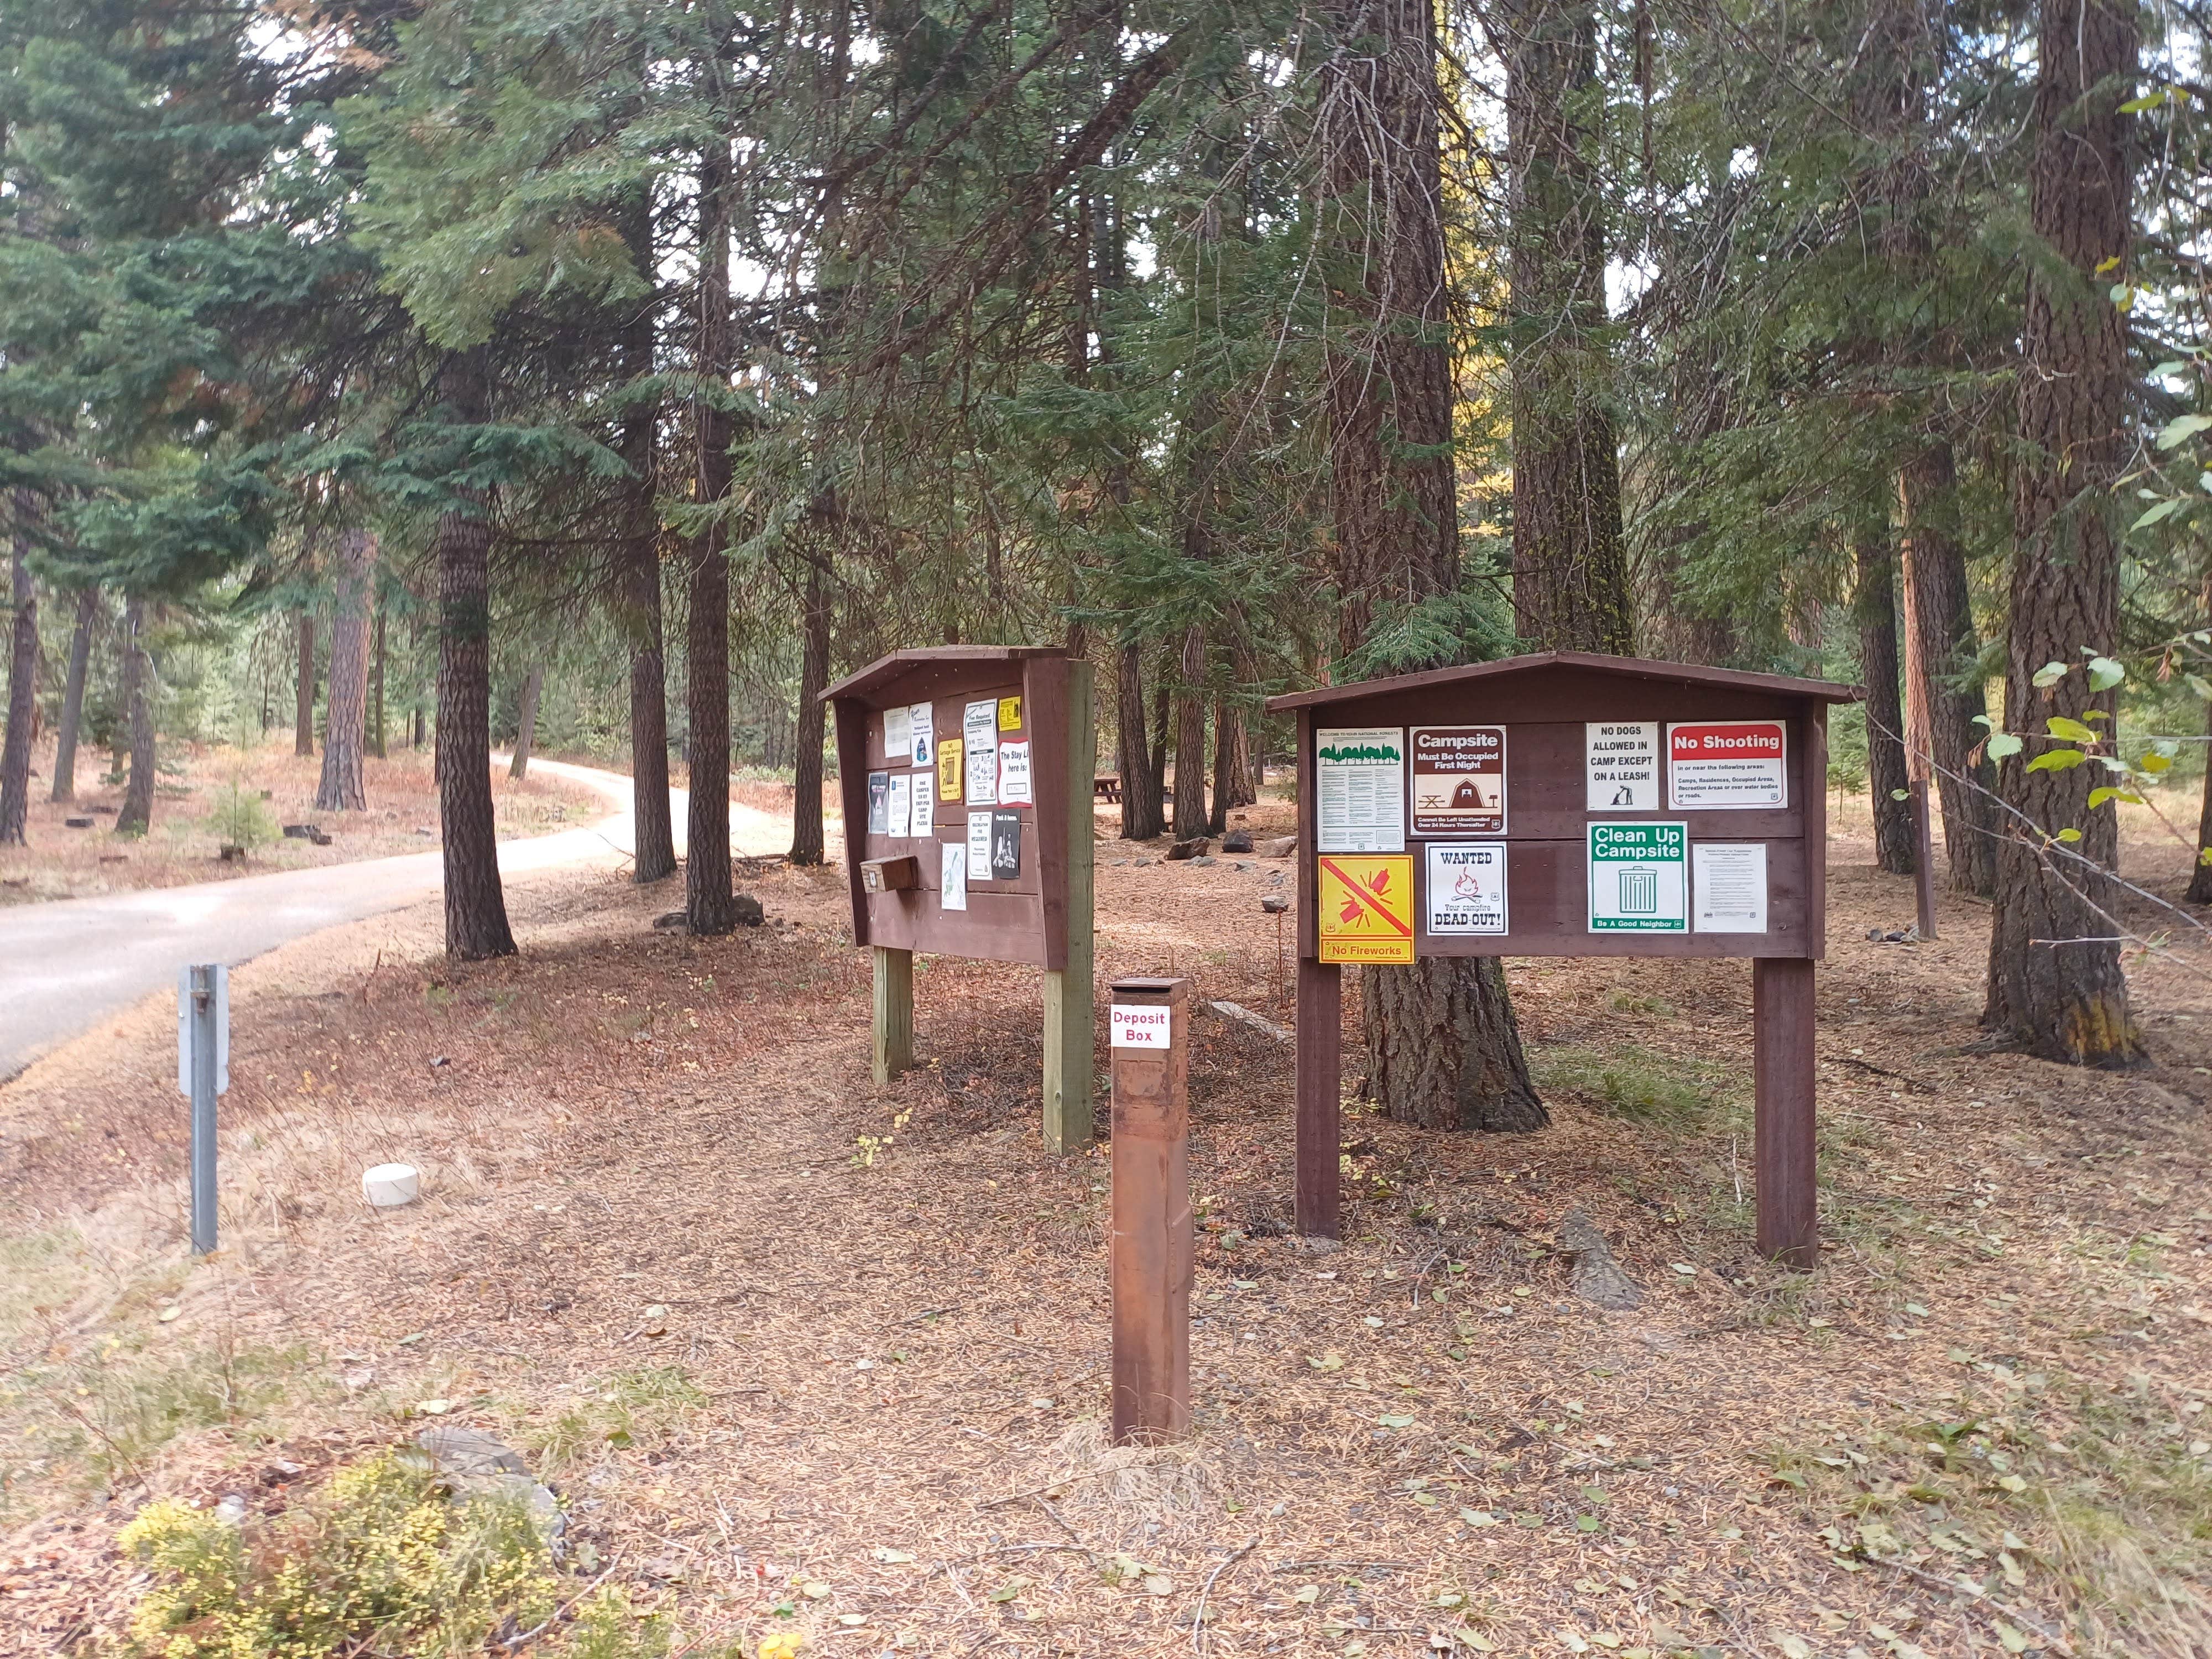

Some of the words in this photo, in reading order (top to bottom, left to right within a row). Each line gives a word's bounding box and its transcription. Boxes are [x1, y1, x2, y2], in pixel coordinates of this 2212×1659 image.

[1601, 727, 1614, 735] NO
[1616, 726, 1641, 735] DOGS
[1418, 733, 1498, 749] Campsite
[1593, 742, 1635, 750] ALLOWED
[1638, 741, 1647, 750] IN
[1674, 736, 1698, 749] No
[1703, 734, 1779, 749] Shooting
[1001, 752, 1010, 760] The
[1011, 750, 1022, 760] Stay
[1455, 752, 1499, 761] Occupied
[1457, 761, 1481, 770] Night
[1590, 757, 1615, 766] CAMP
[1618, 757, 1652, 765] EXCEPT
[1008, 764, 1019, 773] here
[1594, 772, 1606, 781] ON
[1609, 772, 1616, 781] A
[1618, 771, 1650, 780] LEASH!
[1595, 827, 1646, 842] Clean
[1656, 828, 1680, 845] Up
[1595, 844, 1680, 860] Campsite
[1441, 852, 1492, 864] WANTED
[1332, 946, 1347, 955] No
[1350, 946, 1401, 955] Fireworks
[1114, 1011, 1165, 1025] Deposit
[1126, 1030, 1152, 1041] Box
